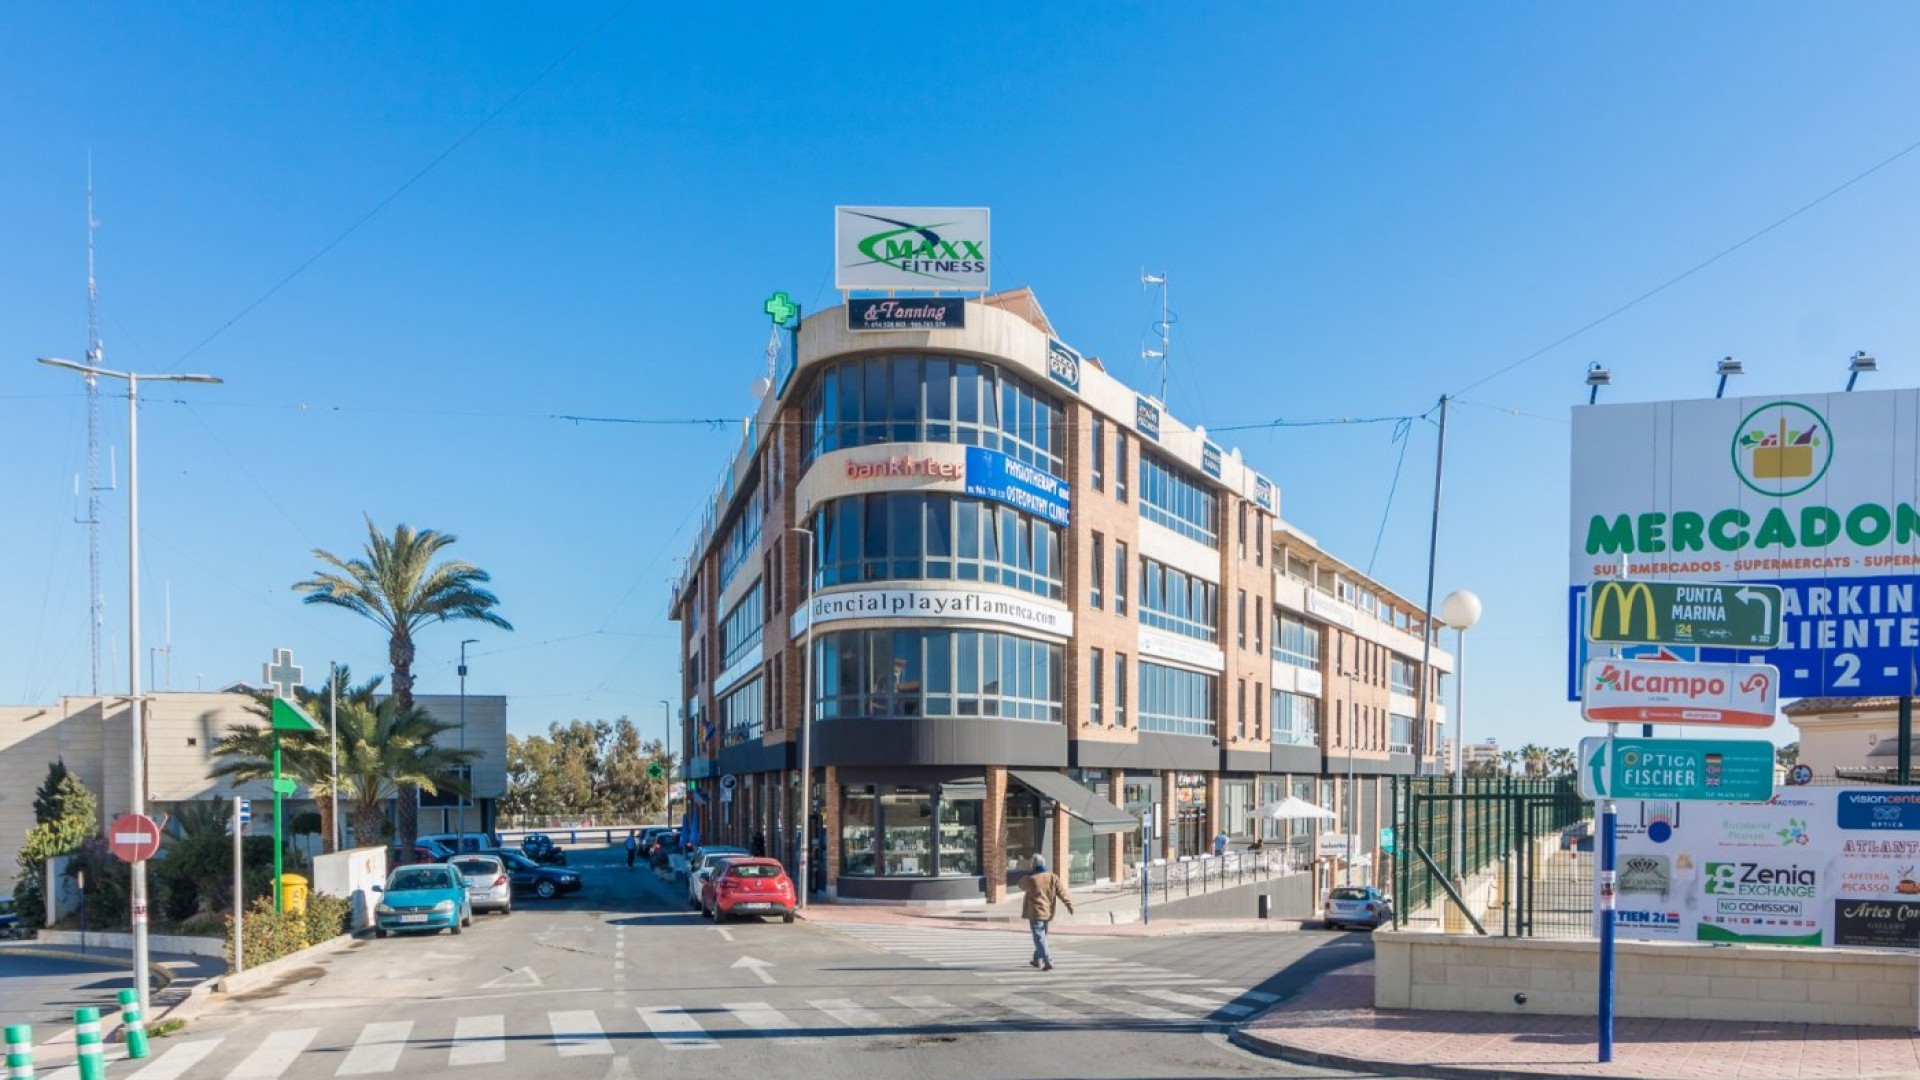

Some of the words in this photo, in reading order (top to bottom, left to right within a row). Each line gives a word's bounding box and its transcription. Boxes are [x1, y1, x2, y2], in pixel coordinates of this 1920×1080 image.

[885, 239, 985, 260] MAXX
[902, 260, 986, 273] FITNESS
[879, 301, 946, 321] Tanning
[845, 456, 964, 480] bankinter
[1004, 457, 1058, 496] PHYSIOTHERAPY
[1006, 485, 1049, 515] OSTEOPATHY
[1048, 502, 1070, 525] CLINIC
[1733, 556, 1851, 572] SUPERMERCATS
[1676, 586, 1723, 604] PUNTA
[1672, 604, 1726, 622] MARINA
[1595, 663, 1725, 699] Alcampo
[1624, 769, 1696, 786] FISCHER
[1740, 863, 1816, 885] Zenia
[1739, 884, 1816, 898] EXCHANGE
[1842, 883, 1890, 893] PICASSO
[1720, 902, 1737, 911] NO
[1738, 903, 1799, 913] COMISSION
